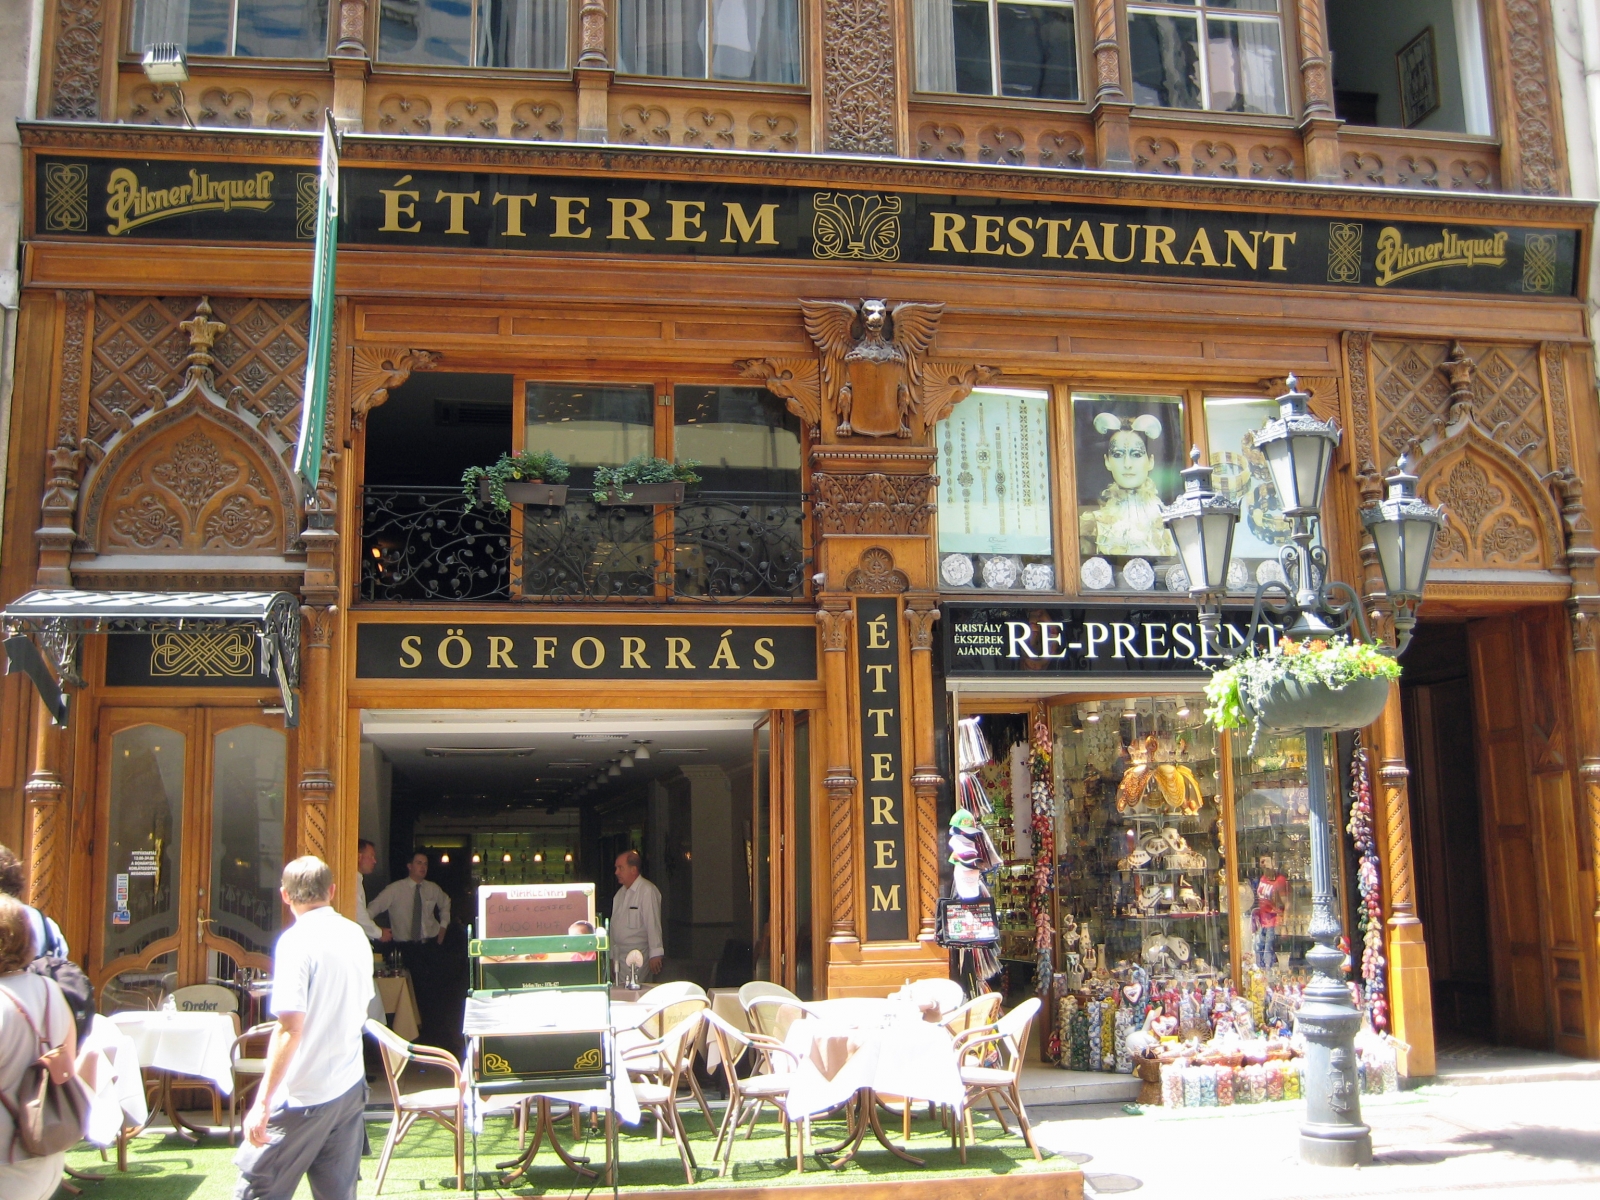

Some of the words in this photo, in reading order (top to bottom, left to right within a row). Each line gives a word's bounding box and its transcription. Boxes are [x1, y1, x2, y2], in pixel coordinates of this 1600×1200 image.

[106, 168, 192, 236] Pilsner
[189, 168, 274, 212] Urquell
[378, 174, 780, 245] ÉTTEREM
[928, 211, 1297, 271] RESTAURANT
[1375, 227, 1443, 286] Pilsner
[1442, 229, 1508, 268] Urquell
[954, 622, 1002, 633] KRISTÁLY
[954, 634, 1004, 644] ÉKSZEREK
[399, 628, 775, 670] SÖRFORRÁS
[956, 645, 1003, 656] AJÁNDÉK
[866, 614, 901, 912] ÉTTEREM
[488, 904, 519, 915] CAKE
[497, 921, 531, 933] 1000
[182, 1000, 218, 1011] Dreher
